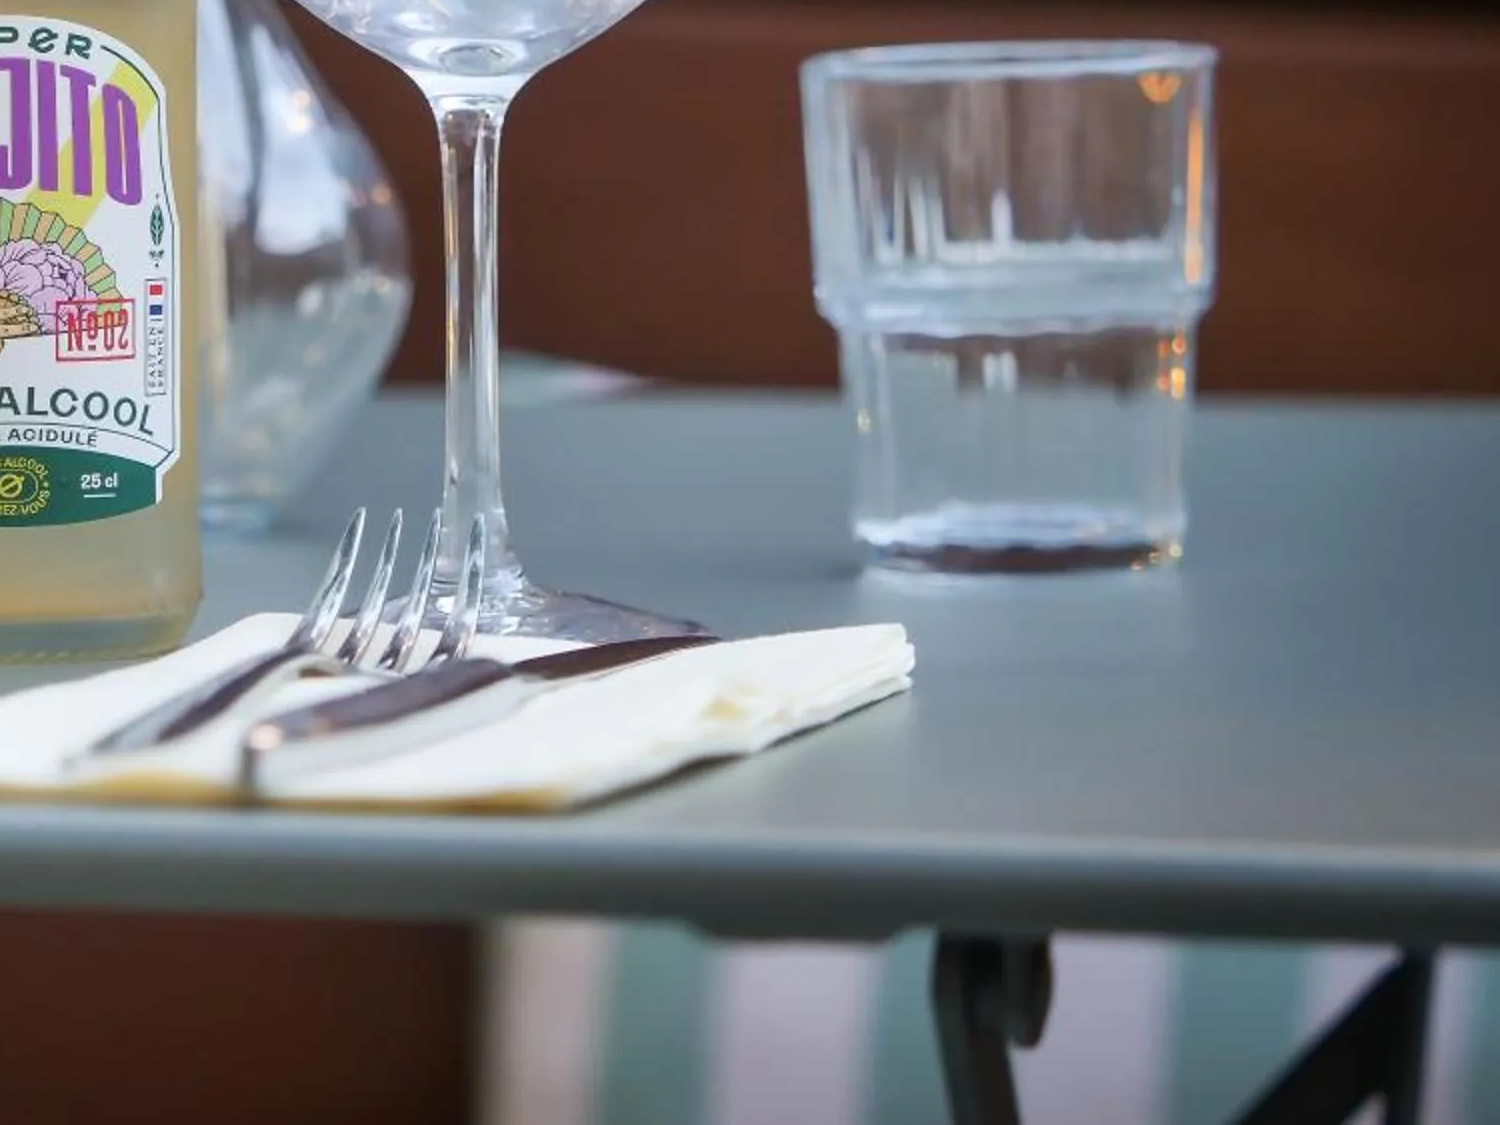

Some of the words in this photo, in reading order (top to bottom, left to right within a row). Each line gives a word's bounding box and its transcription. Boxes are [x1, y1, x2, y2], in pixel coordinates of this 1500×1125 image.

[7, 427, 100, 448] ACIDULÉ
[3, 456, 50, 481] ALCOOL
[80, 474, 101, 489] 25
[103, 472, 119, 488] cl
